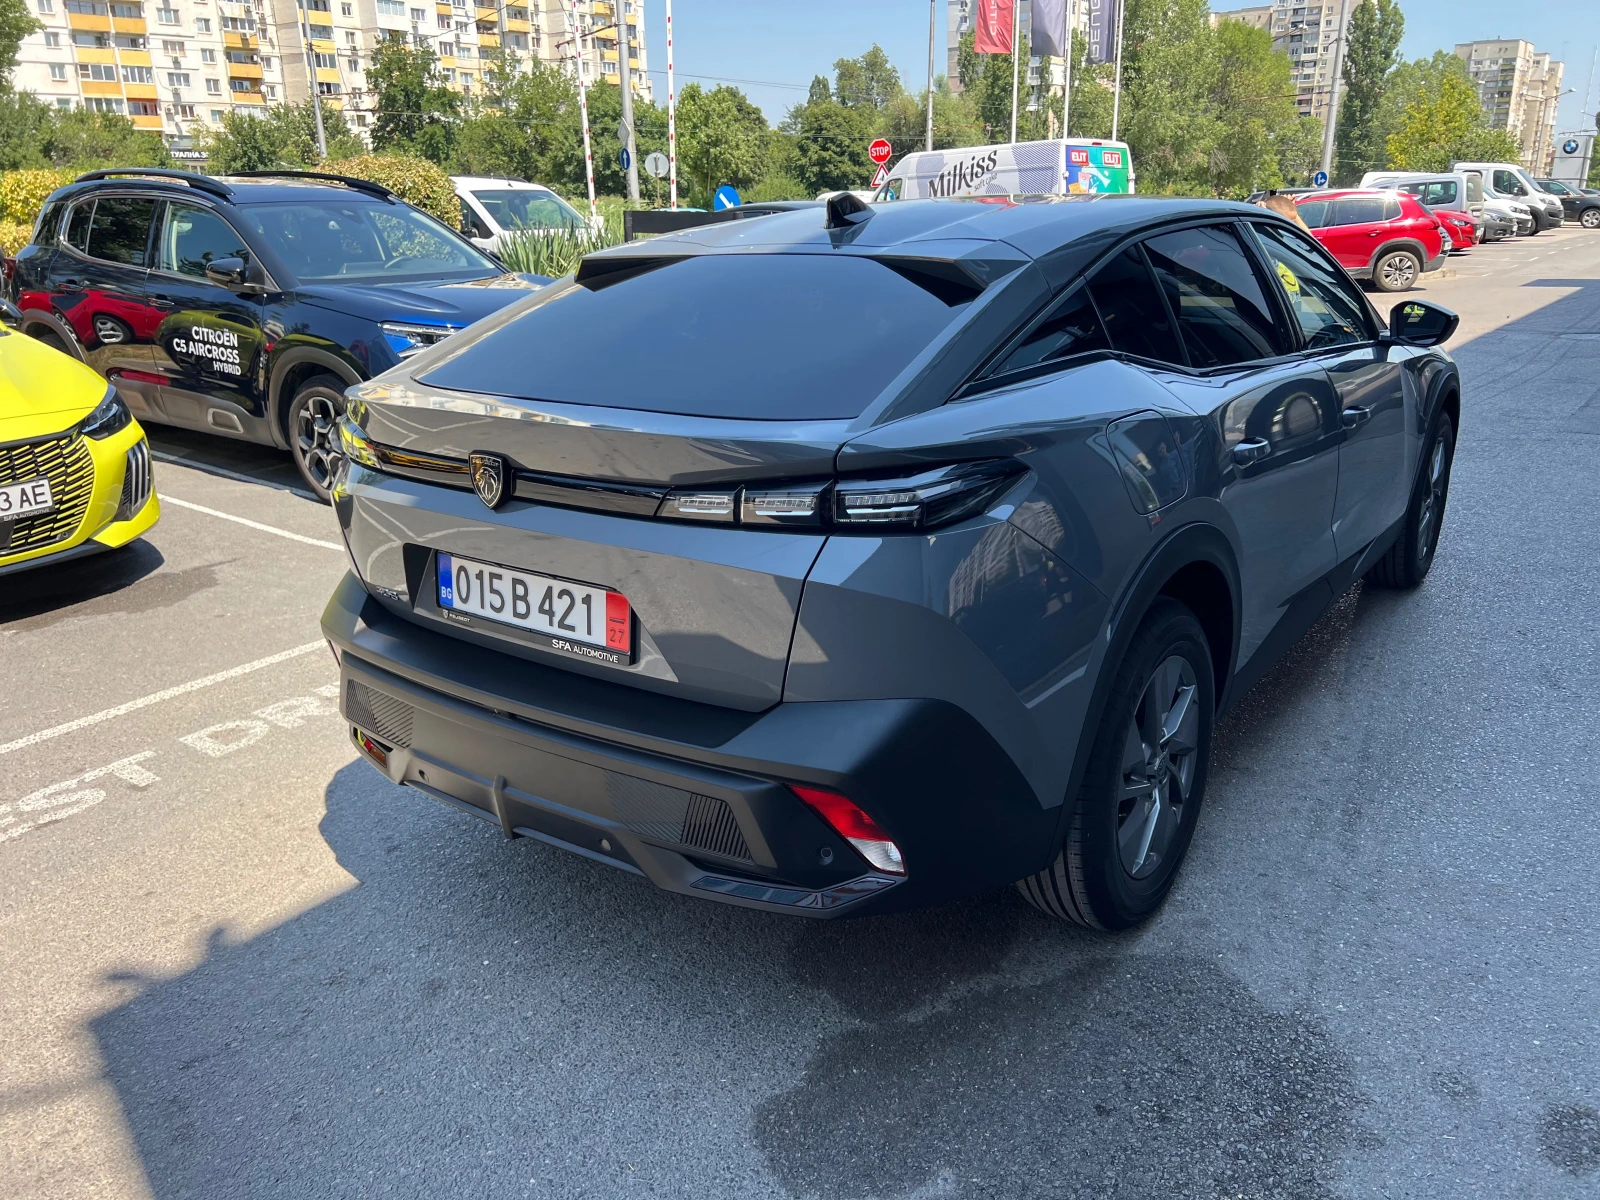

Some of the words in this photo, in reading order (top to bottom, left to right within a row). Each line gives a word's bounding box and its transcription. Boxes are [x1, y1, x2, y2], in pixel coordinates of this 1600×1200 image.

[871, 146, 889, 157] STOP
[1071, 151, 1087, 163] ELIT
[1104, 153, 1120, 164] ELIT
[928, 149, 998, 198] Milkiss
[191, 325, 239, 348] CITROËN
[173, 337, 187, 353] C5
[188, 340, 240, 364] AIRCROSS
[213, 360, 242, 376] HYBRID
[20, 483, 48, 509] AE
[441, 585, 453, 600] BG
[609, 627, 625, 644] 27
[551, 639, 572, 652] SFA
[573, 645, 619, 664] AUTOMOTIVE
